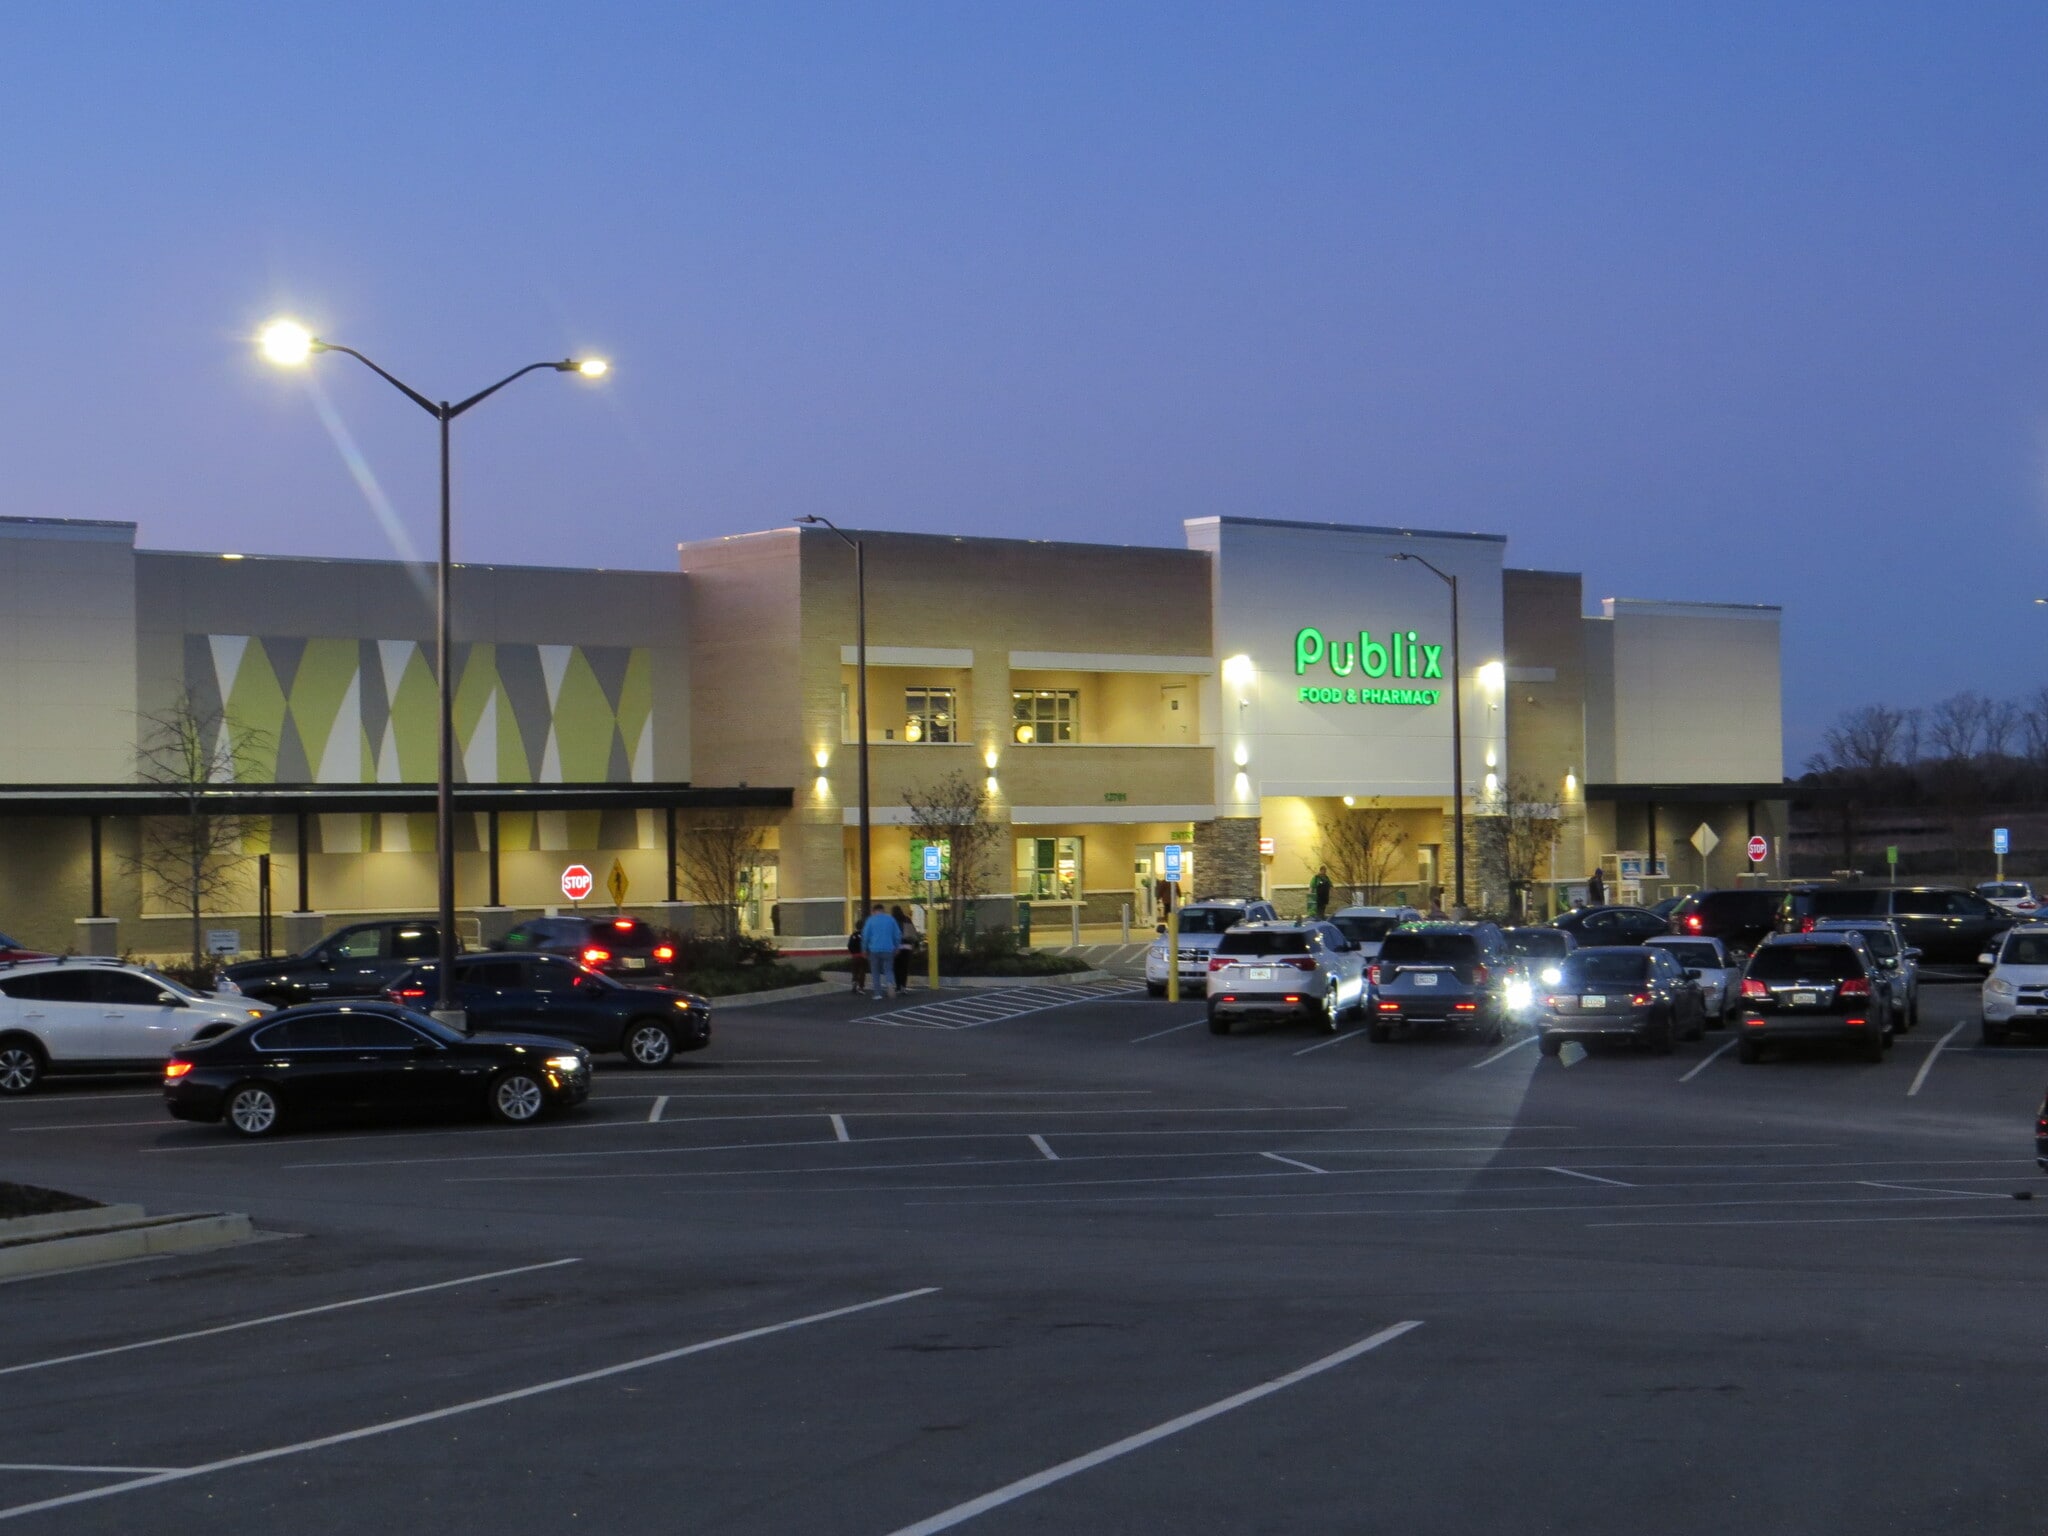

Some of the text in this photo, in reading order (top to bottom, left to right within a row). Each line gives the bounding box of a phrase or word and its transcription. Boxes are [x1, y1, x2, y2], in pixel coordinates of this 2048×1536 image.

[1295, 627, 1442, 679] Publix
[1299, 687, 1441, 706] FOOD & PHARMACY
[1749, 844, 1766, 853] STOP
[564, 875, 590, 890] STOP
